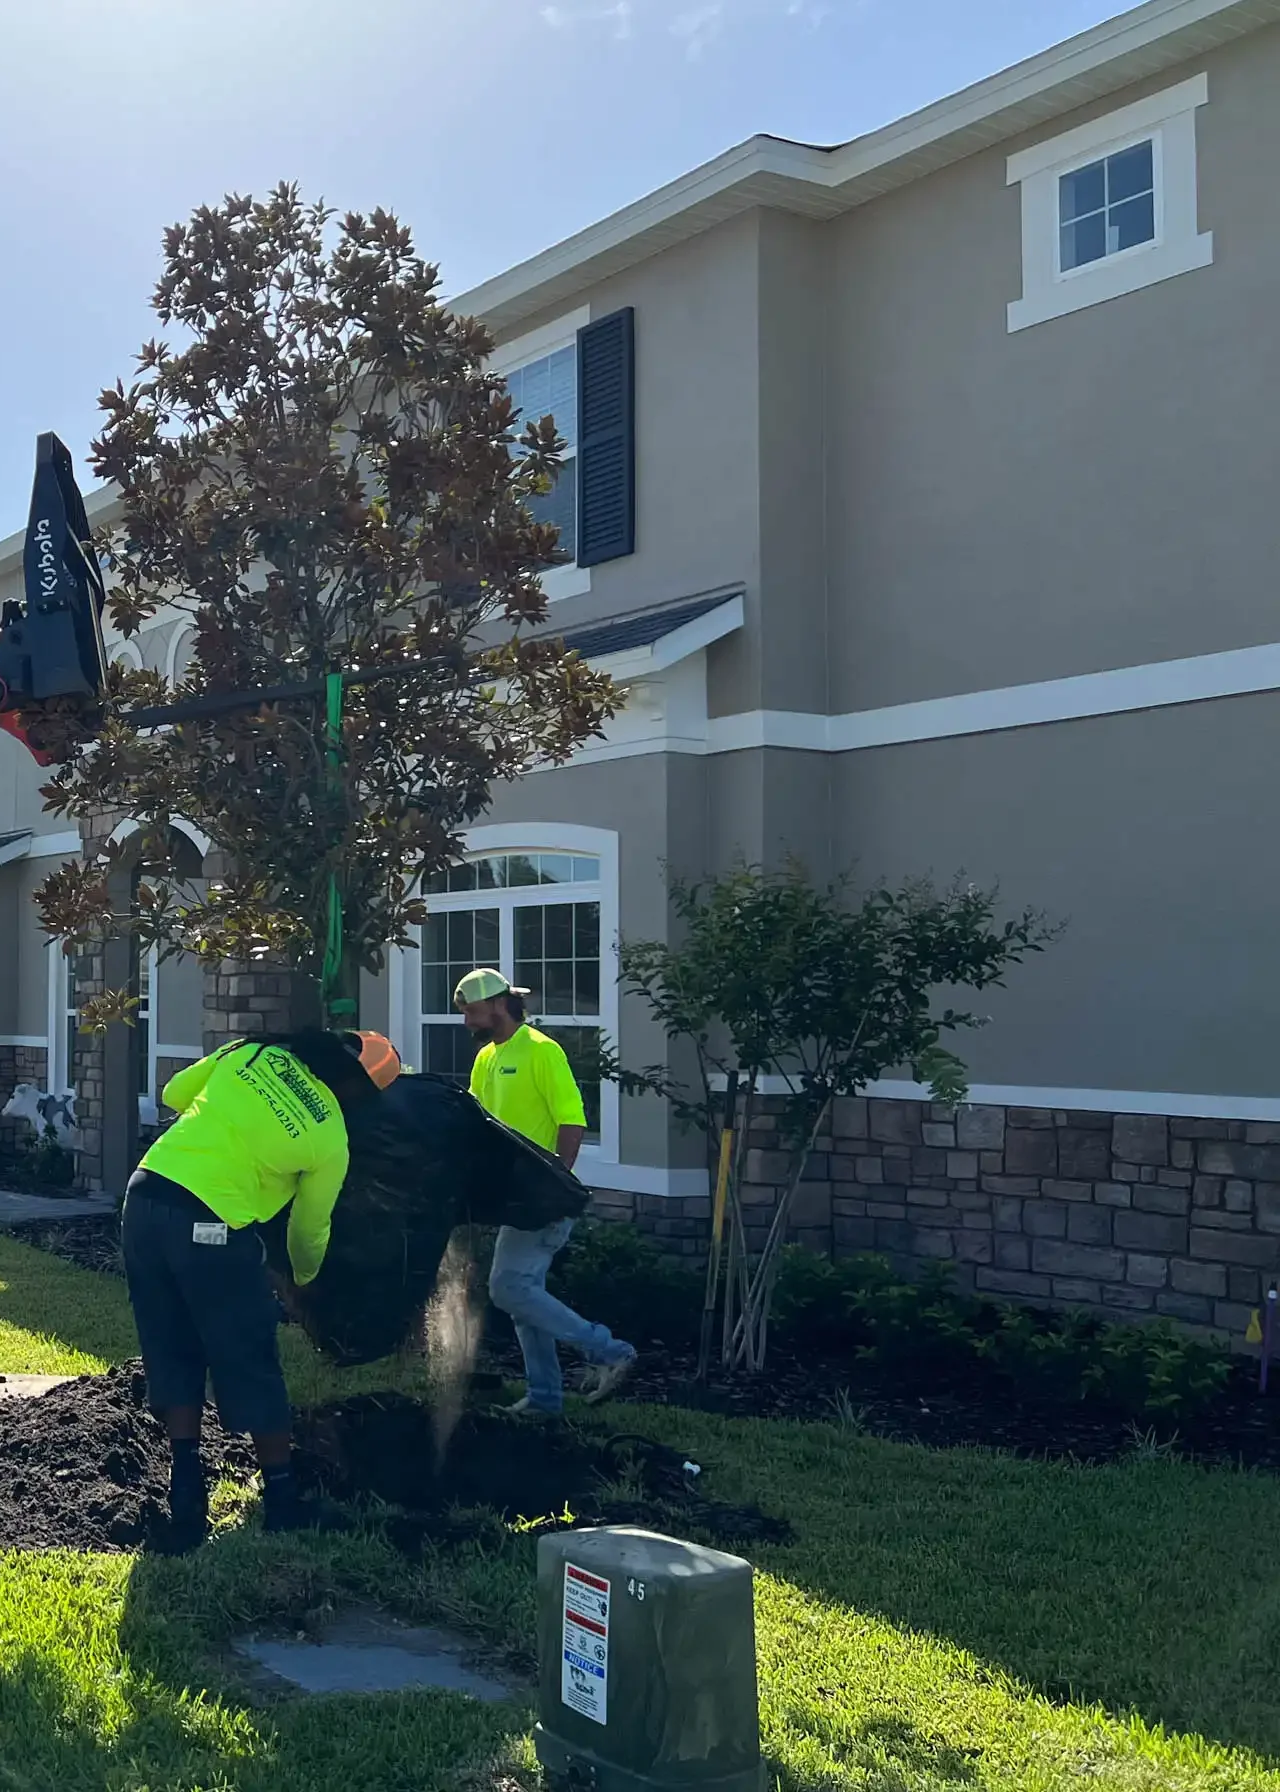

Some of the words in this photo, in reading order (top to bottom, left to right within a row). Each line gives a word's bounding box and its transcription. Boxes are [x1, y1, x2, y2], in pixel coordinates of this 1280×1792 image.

[33, 518, 59, 597] Kubota
[288, 1065, 332, 1118] PARADISE
[627, 1578, 646, 1601] 45
[569, 1653, 600, 1675] NOTICE
